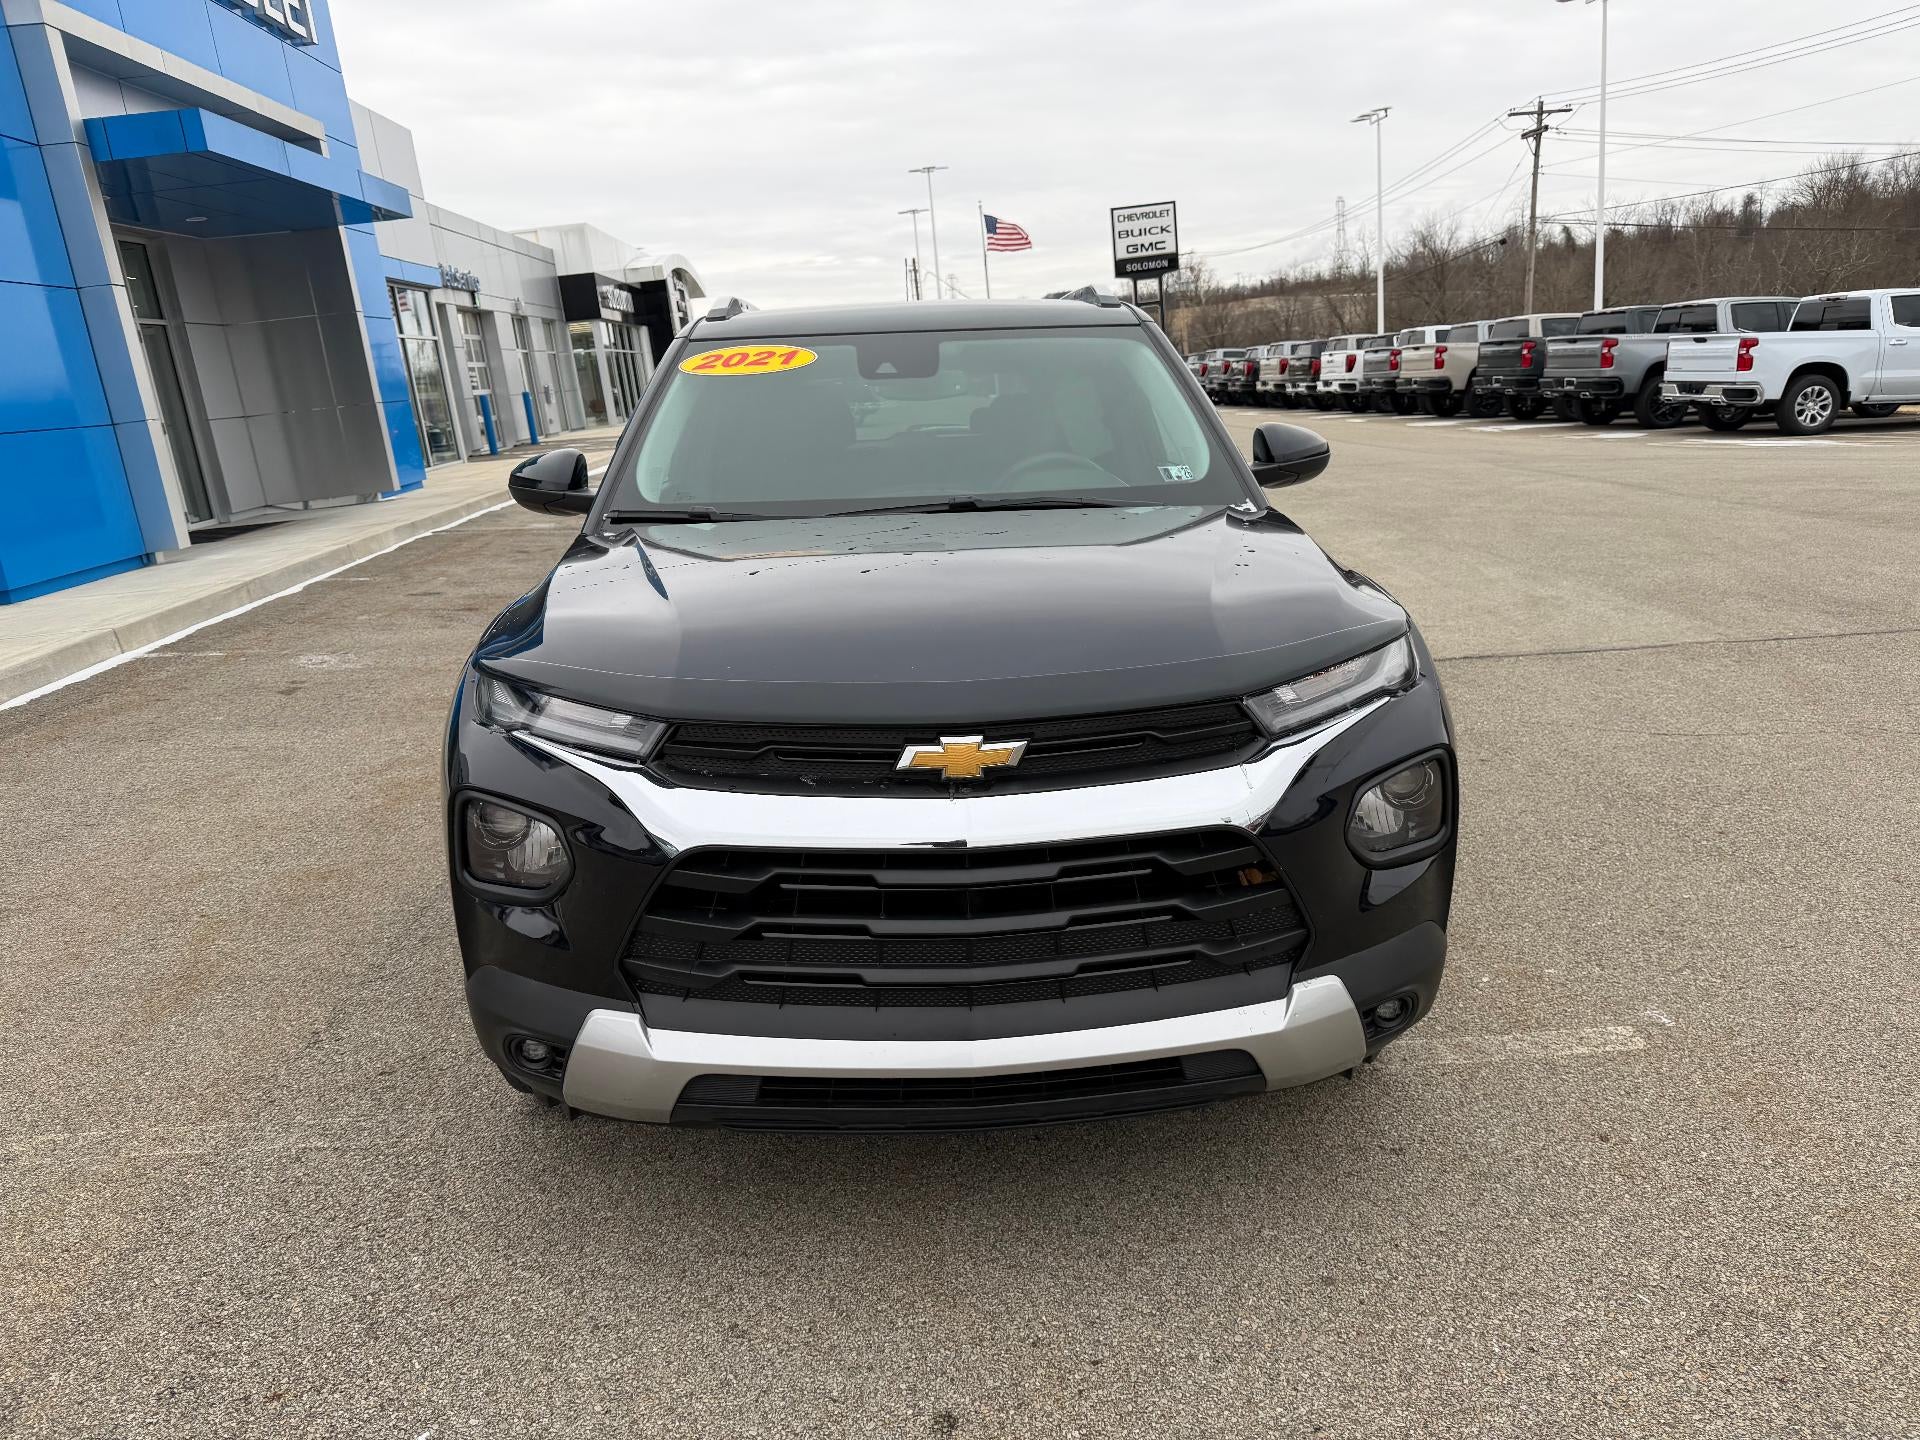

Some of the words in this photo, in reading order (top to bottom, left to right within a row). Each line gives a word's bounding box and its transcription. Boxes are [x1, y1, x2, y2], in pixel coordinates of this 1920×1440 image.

[1117, 209, 1170, 223] CHEVROLET
[1118, 224, 1172, 239] BUICK
[1126, 241, 1166, 254] GMC
[1126, 259, 1169, 272] SOLOMON
[692, 350, 800, 370] 2021
